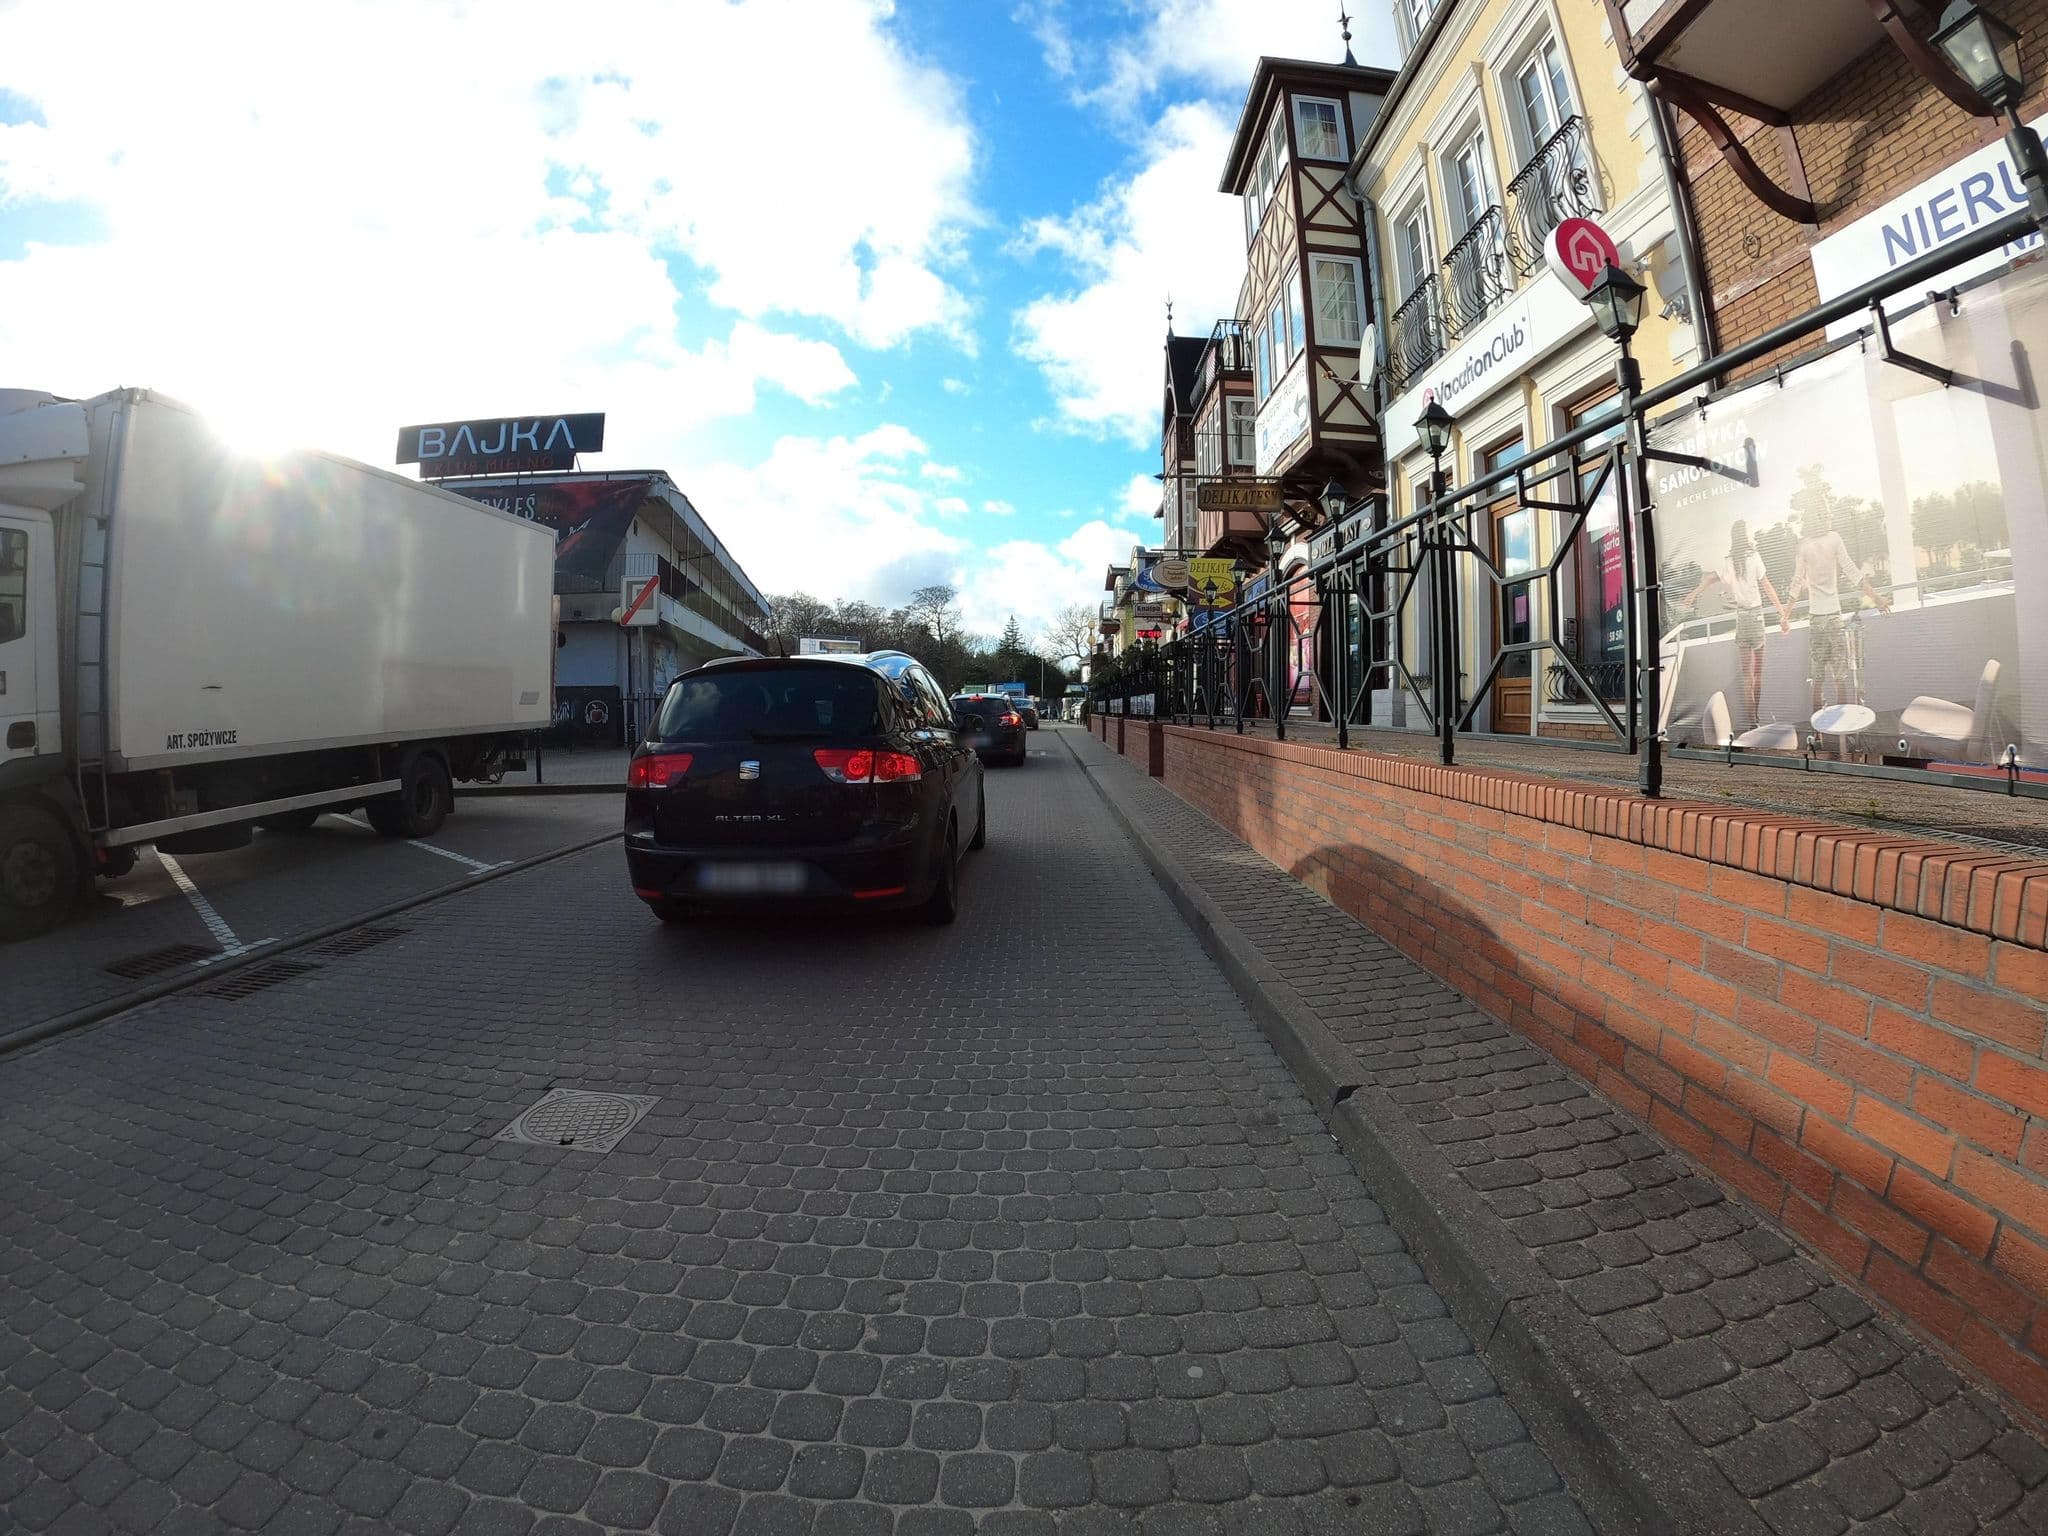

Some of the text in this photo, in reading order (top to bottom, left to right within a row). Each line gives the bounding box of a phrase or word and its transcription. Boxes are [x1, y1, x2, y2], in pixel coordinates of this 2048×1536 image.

[1881, 134, 2048, 266] NIERU
[1434, 322, 1525, 407] VacationClub
[418, 418, 575, 458] BAJKA
[167, 728, 237, 750] ART. SPOŻYWCZE
